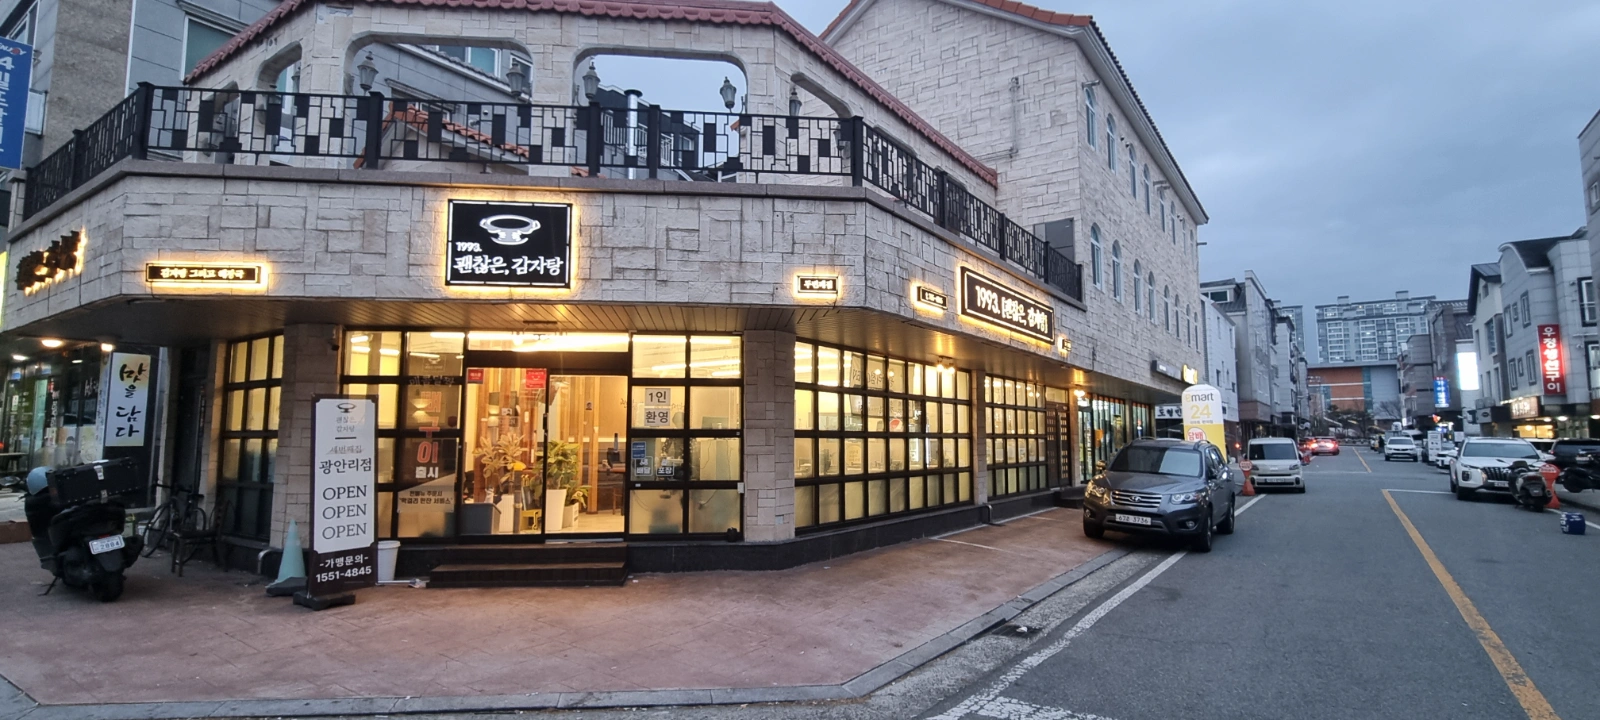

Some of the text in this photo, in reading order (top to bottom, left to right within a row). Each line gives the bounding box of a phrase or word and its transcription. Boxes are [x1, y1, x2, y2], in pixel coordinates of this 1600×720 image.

[455, 241, 482, 252] 1993.
[453, 255, 564, 276] 괜찮은, 감자탕
[975, 285, 1000, 315] 1993.
[119, 362, 147, 399] 맛을
[648, 391, 667, 404] 1인
[1185, 392, 1214, 403] emart
[645, 411, 669, 424] 환영
[1190, 404, 1212, 420] 24
[115, 405, 142, 438] 담다
[318, 457, 373, 475] 광안리점
[415, 466, 439, 479] 출시
[322, 484, 368, 501] OPEN
[322, 503, 368, 520] OPEN
[322, 522, 368, 540] OPEN
[315, 565, 372, 583] 1551-4845
